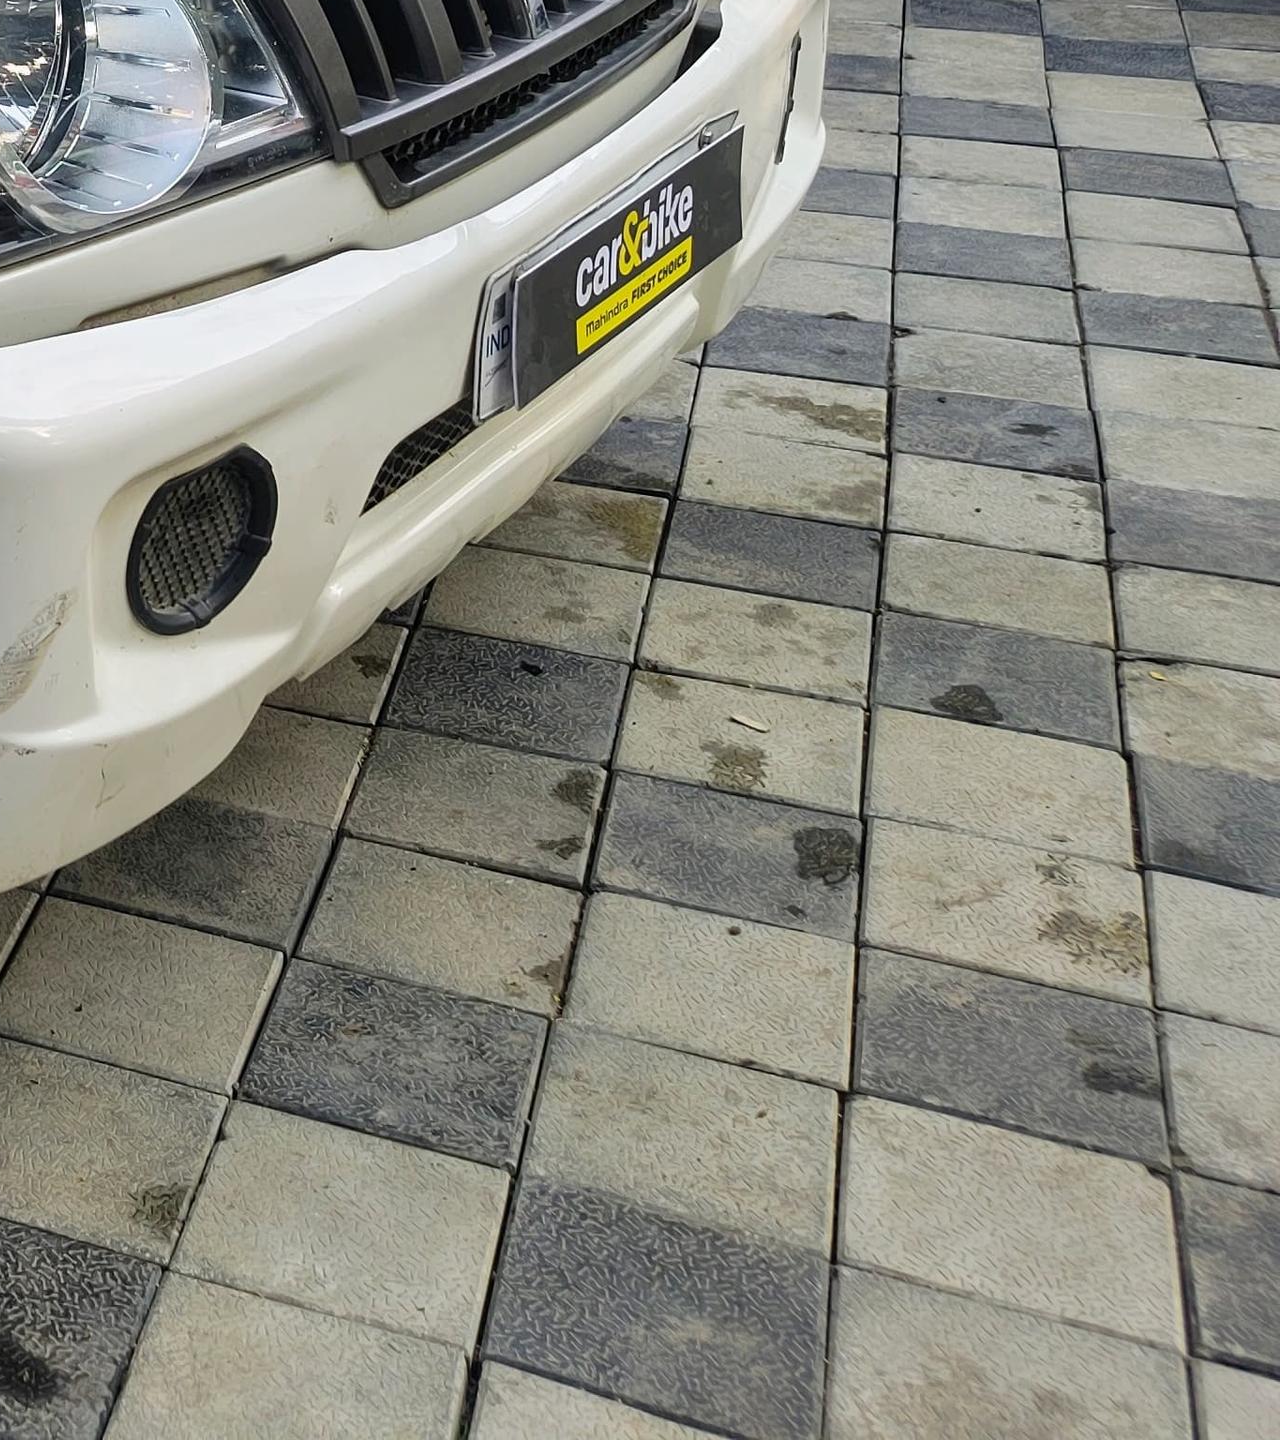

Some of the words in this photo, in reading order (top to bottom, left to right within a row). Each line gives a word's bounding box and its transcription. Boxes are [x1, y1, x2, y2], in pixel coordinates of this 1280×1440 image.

[575, 182, 694, 308] car&bike
[585, 297, 629, 338] Mahindra
[630, 278, 657, 305] FIRST
[656, 249, 688, 282] CHOICE
[485, 323, 511, 359] IND
